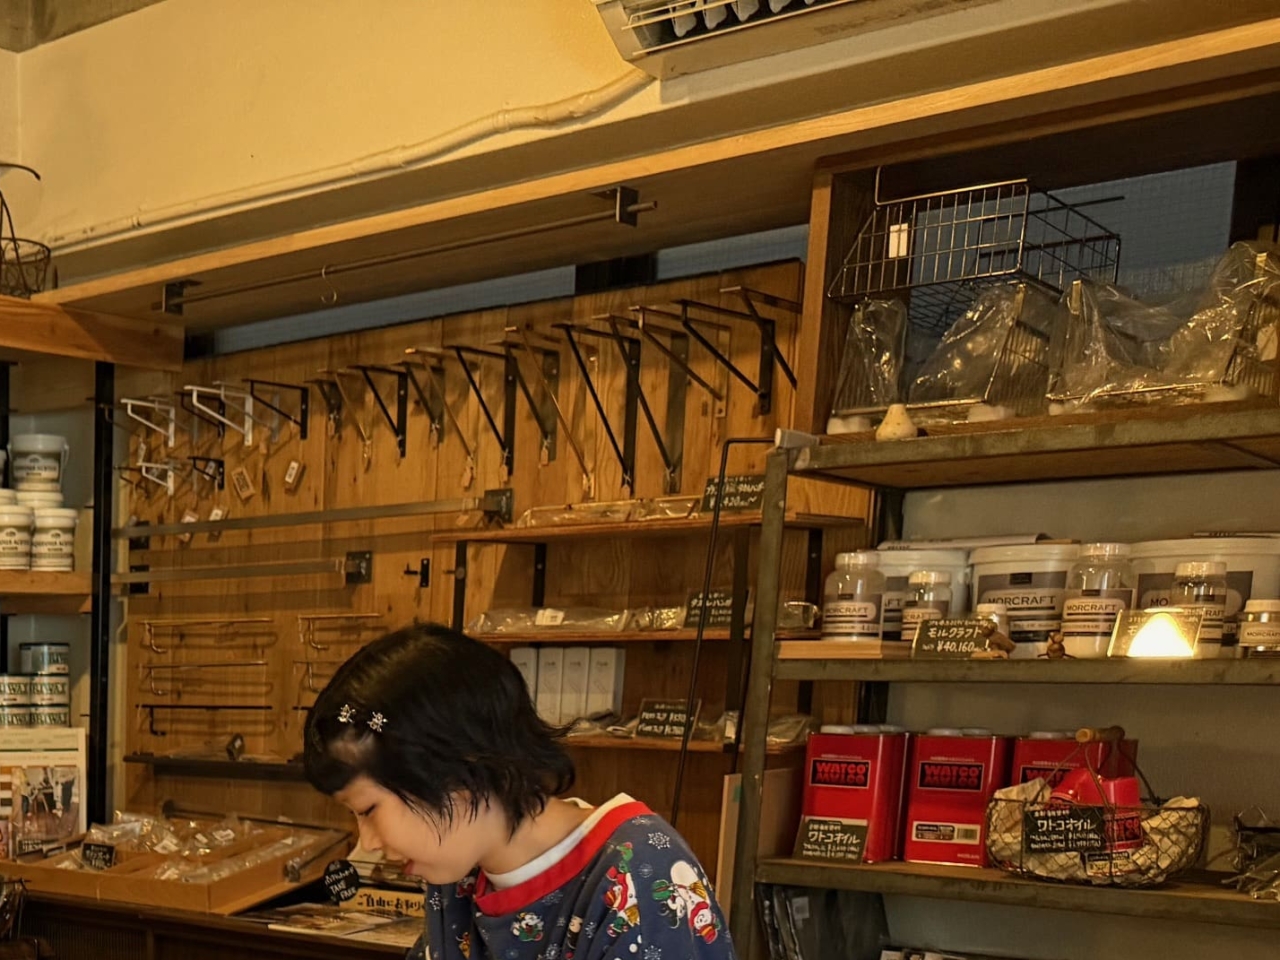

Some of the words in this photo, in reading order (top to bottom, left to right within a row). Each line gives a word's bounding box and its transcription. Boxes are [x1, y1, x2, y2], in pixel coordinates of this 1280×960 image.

[988, 595, 1057, 606] MORCRAFT
[1067, 604, 1117, 612] MORCRAFT
[928, 626, 983, 639] モルクラフト
[816, 762, 866, 775] WATCO
[924, 764, 979, 777] WATCO
[1037, 818, 1097, 832] ワトコオイル
[808, 830, 861, 844] ワトコオイル
